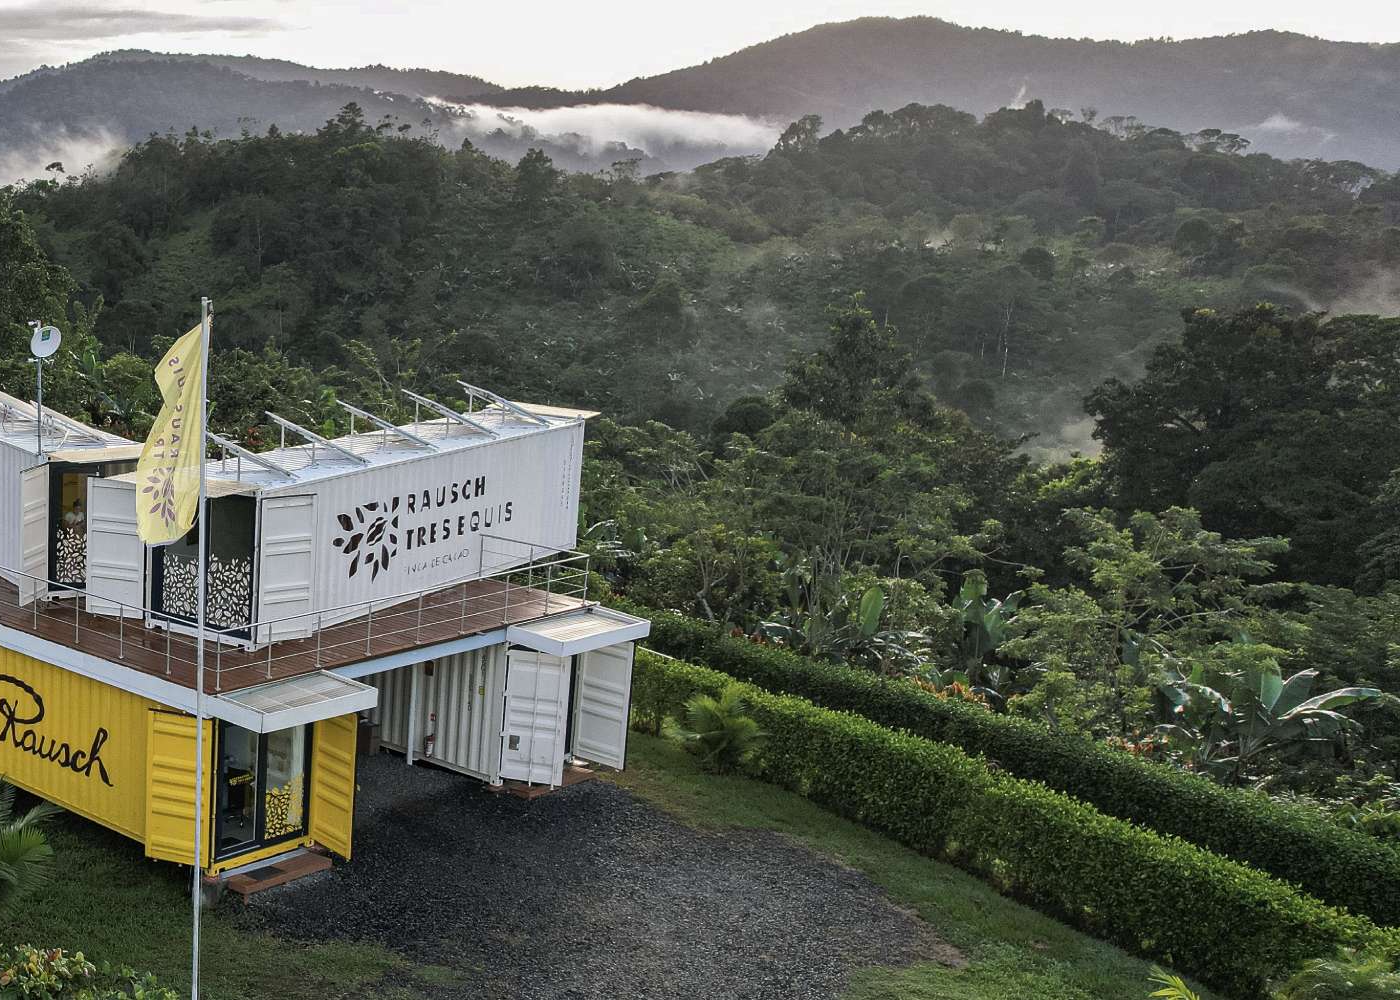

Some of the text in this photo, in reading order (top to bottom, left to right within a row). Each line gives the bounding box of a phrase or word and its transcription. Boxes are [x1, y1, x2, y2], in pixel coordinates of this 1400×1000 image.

[407, 476, 486, 514] RAUSCH
[406, 502, 512, 550] TRES EQUIS
[403, 562, 427, 575] INCA
